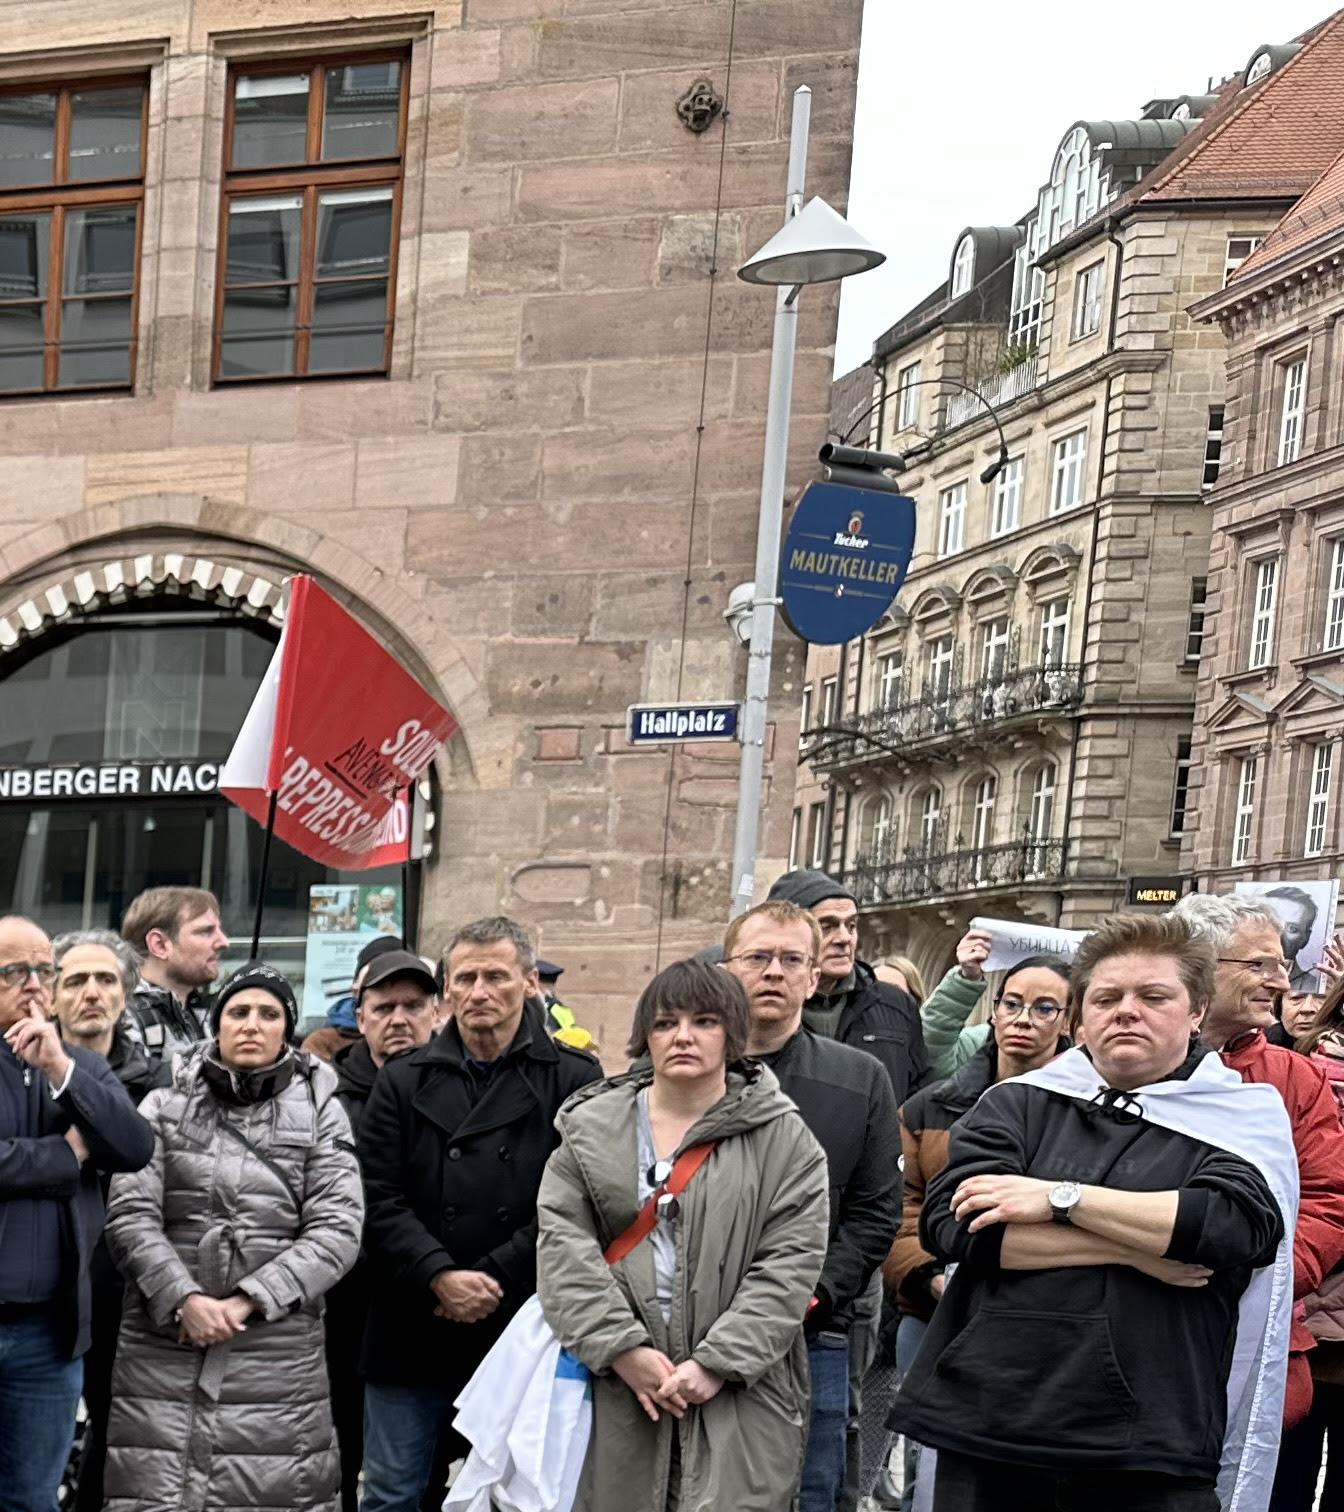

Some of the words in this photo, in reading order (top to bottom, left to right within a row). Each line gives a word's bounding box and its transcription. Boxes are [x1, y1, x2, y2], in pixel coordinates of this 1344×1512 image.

[789, 550, 900, 585] MAUTKELLER
[640, 710, 726, 737] Hallplatz
[1136, 889, 1177, 901] MELTER
